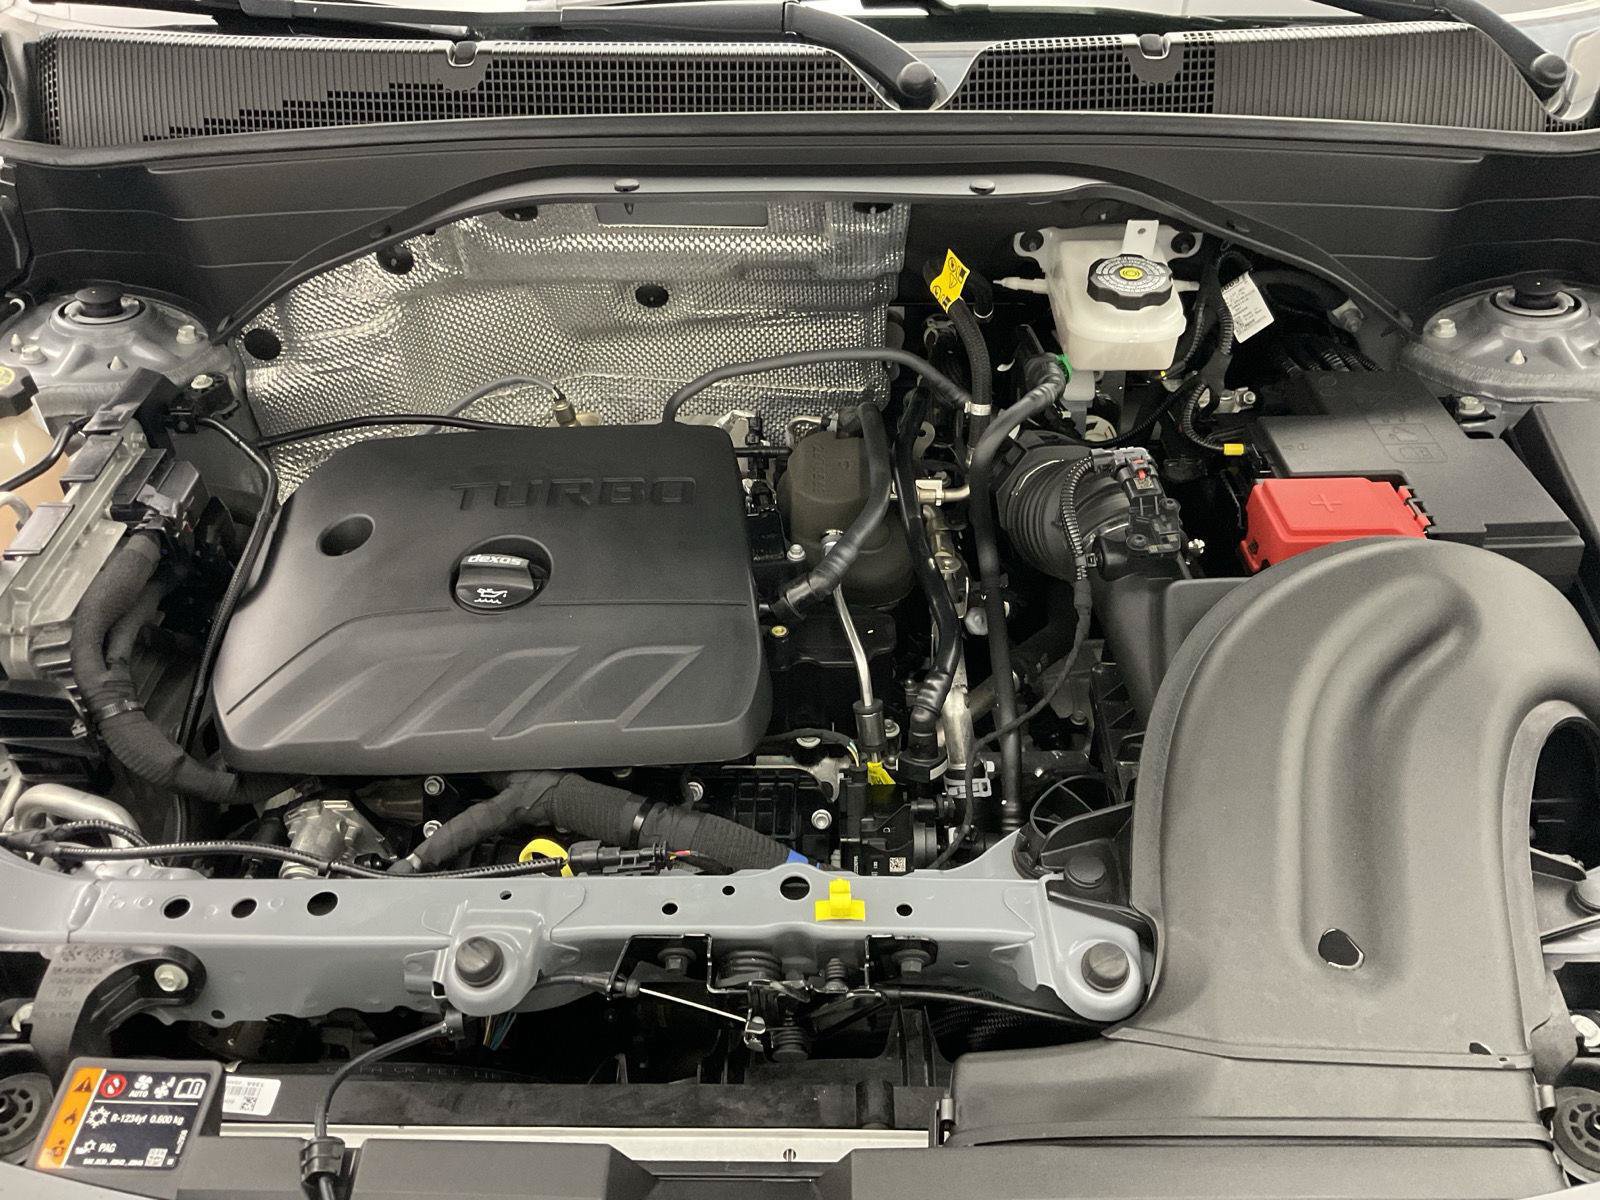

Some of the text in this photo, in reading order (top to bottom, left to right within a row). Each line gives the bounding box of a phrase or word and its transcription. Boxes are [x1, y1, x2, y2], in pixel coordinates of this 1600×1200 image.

[450, 477, 697, 510] TURBO
[467, 553, 523, 566] dexos
[128, 1090, 149, 1098] AUTO
[110, 1113, 185, 1126] R-1234yf 0.600 kg
[97, 1143, 117, 1153] PAG
